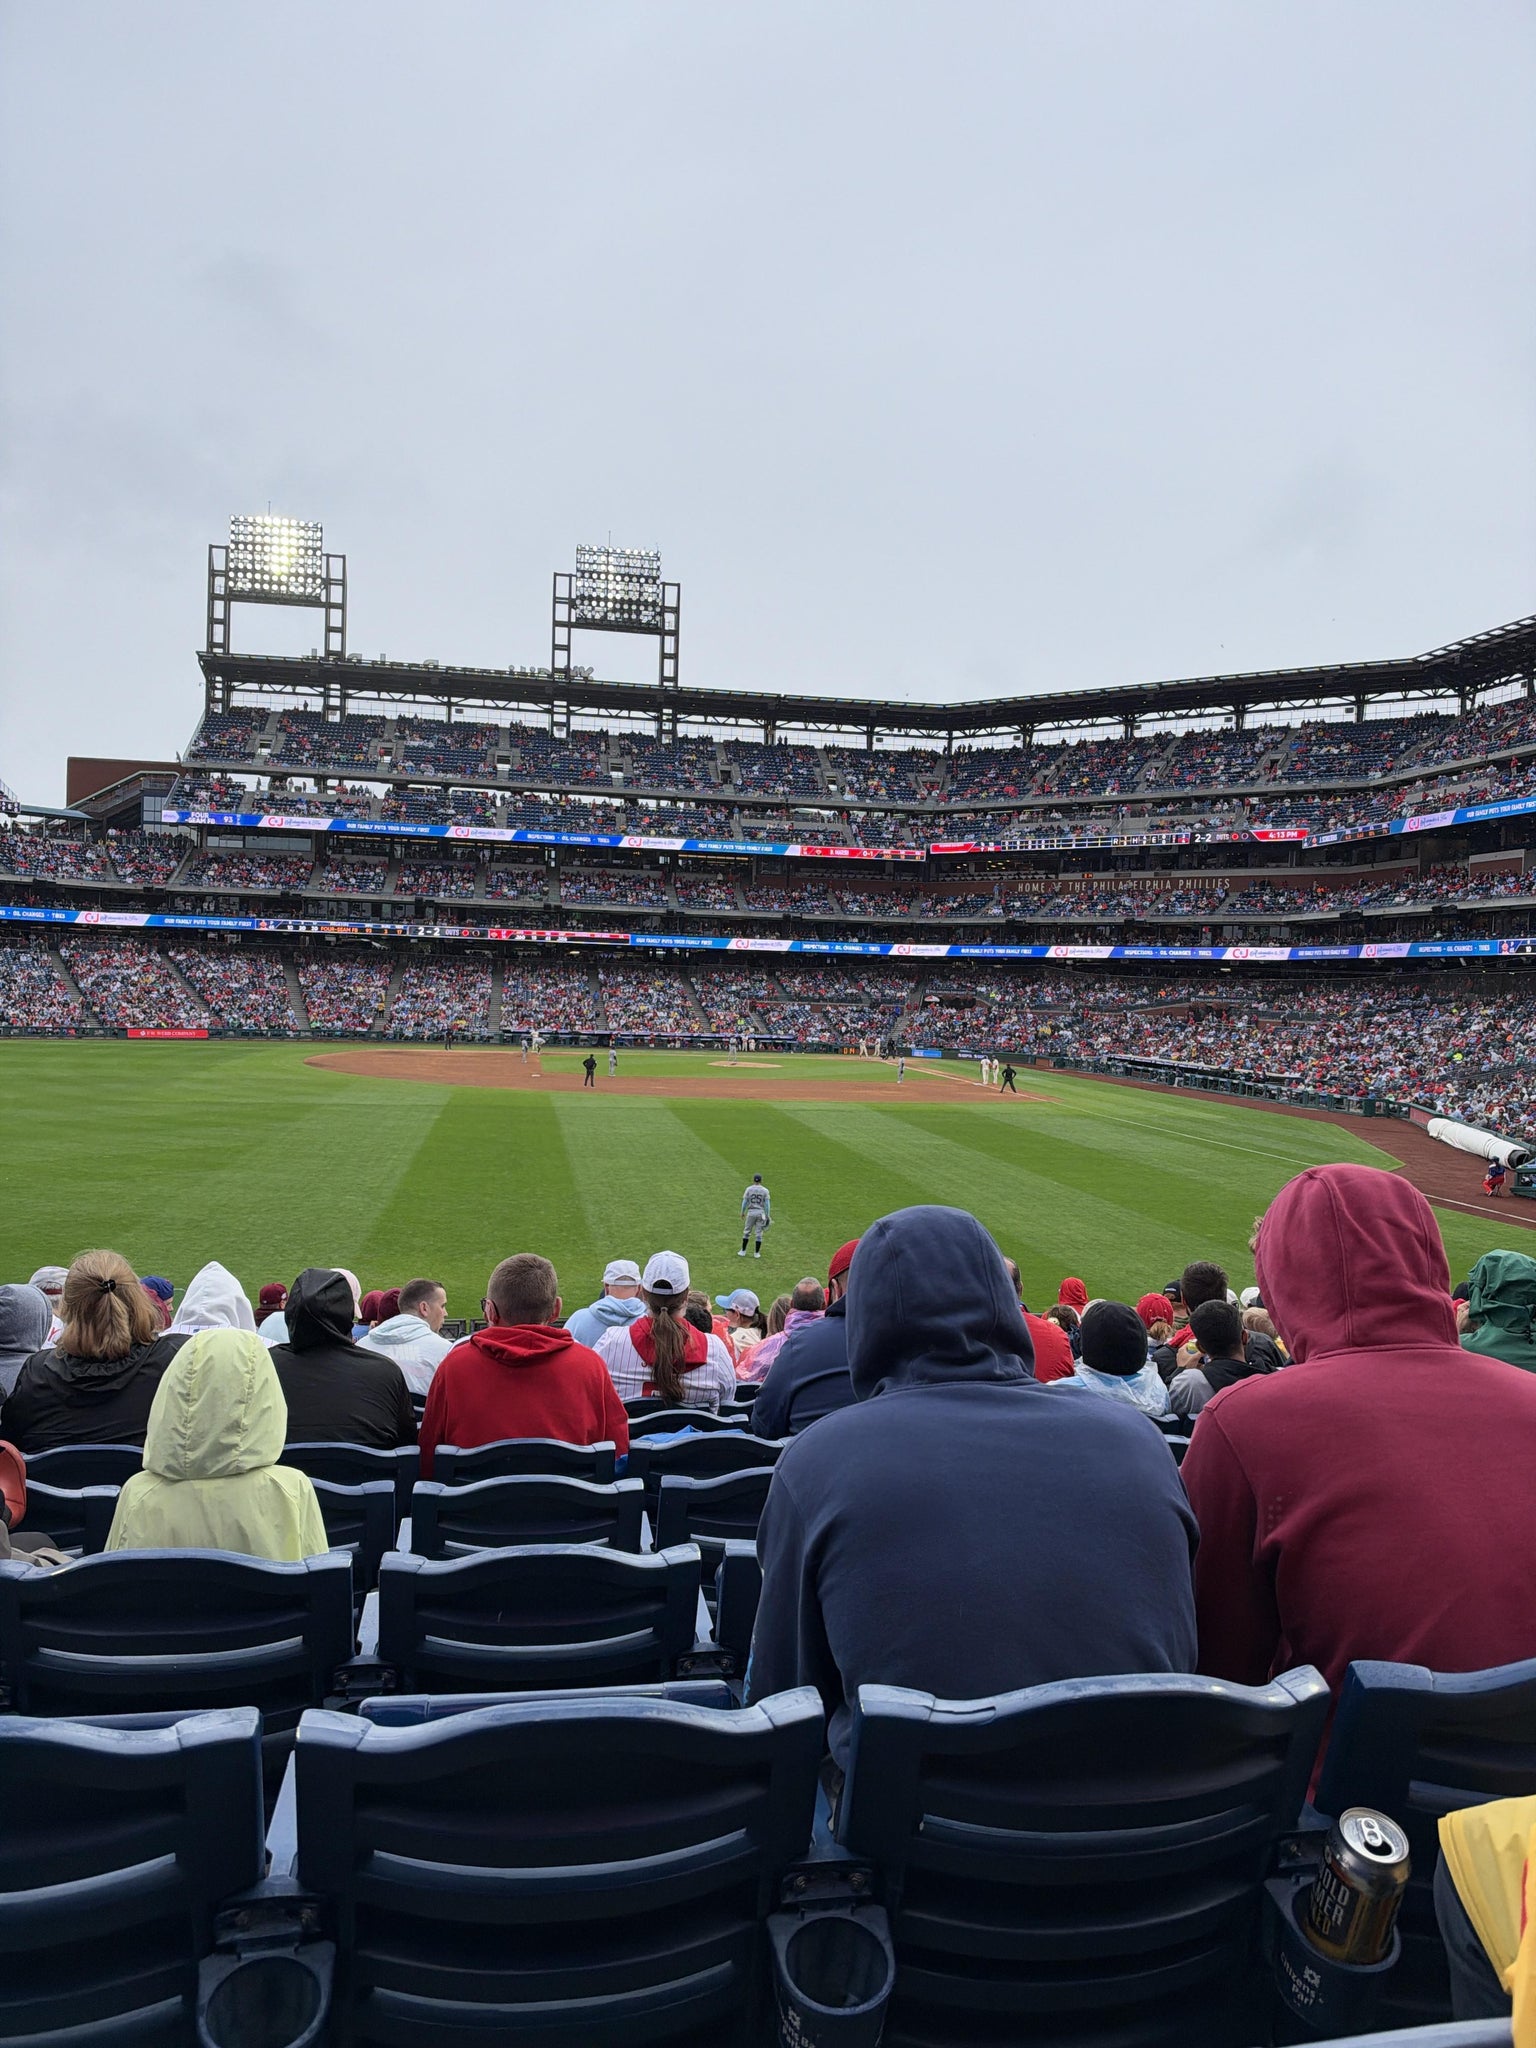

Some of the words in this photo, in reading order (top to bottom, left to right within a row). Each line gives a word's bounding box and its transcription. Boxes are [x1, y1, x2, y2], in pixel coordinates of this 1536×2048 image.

[1195, 834, 1212, 842] 2-2
[1018, 882, 1045, 893] HOME
[1068, 882, 1086, 892] THE
[1093, 880, 1172, 891] PHILAELPHIA
[1178, 878, 1230, 890] PHILLIES
[750, 1194, 763, 1205] 25
